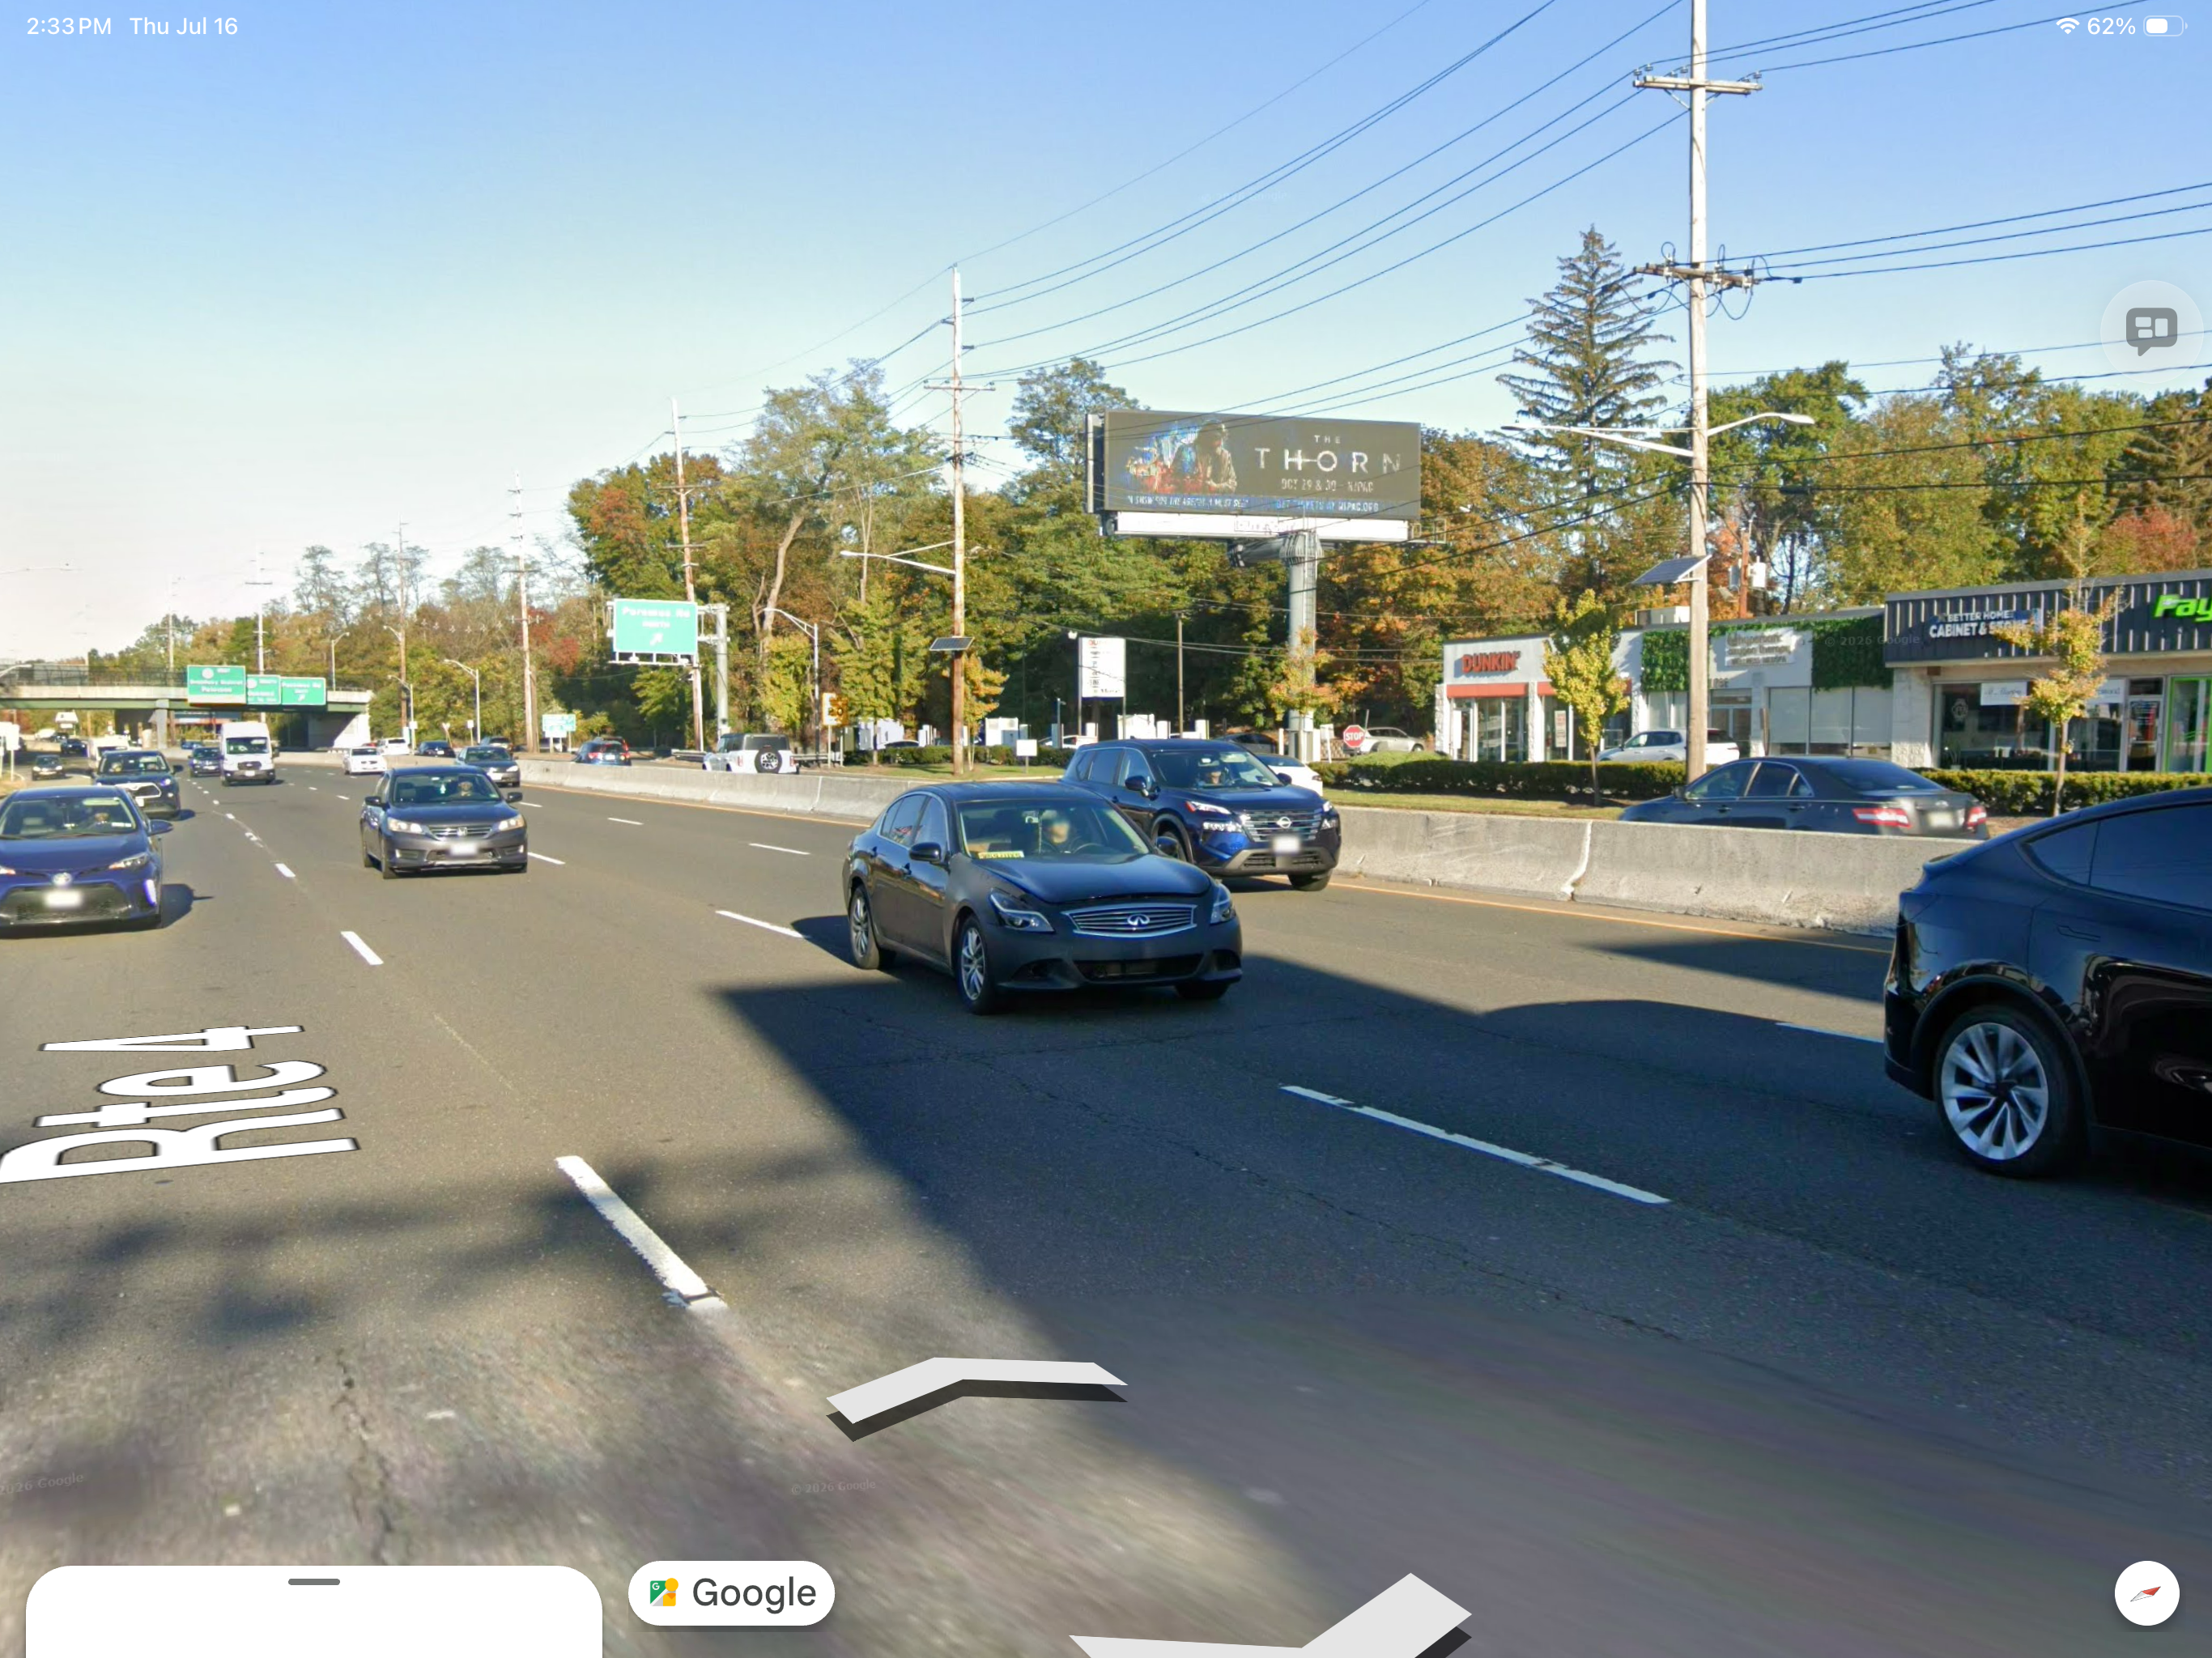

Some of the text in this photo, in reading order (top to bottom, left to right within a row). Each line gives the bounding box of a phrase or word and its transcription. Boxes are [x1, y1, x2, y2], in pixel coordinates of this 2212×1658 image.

[1314, 435, 1341, 444] THE
[1254, 448, 1402, 474] THORN
[1947, 612, 1981, 623] BETTER
[1929, 623, 1978, 638] CABINET
[1978, 622, 1988, 636] &
[1345, 732, 1363, 742] STOP
